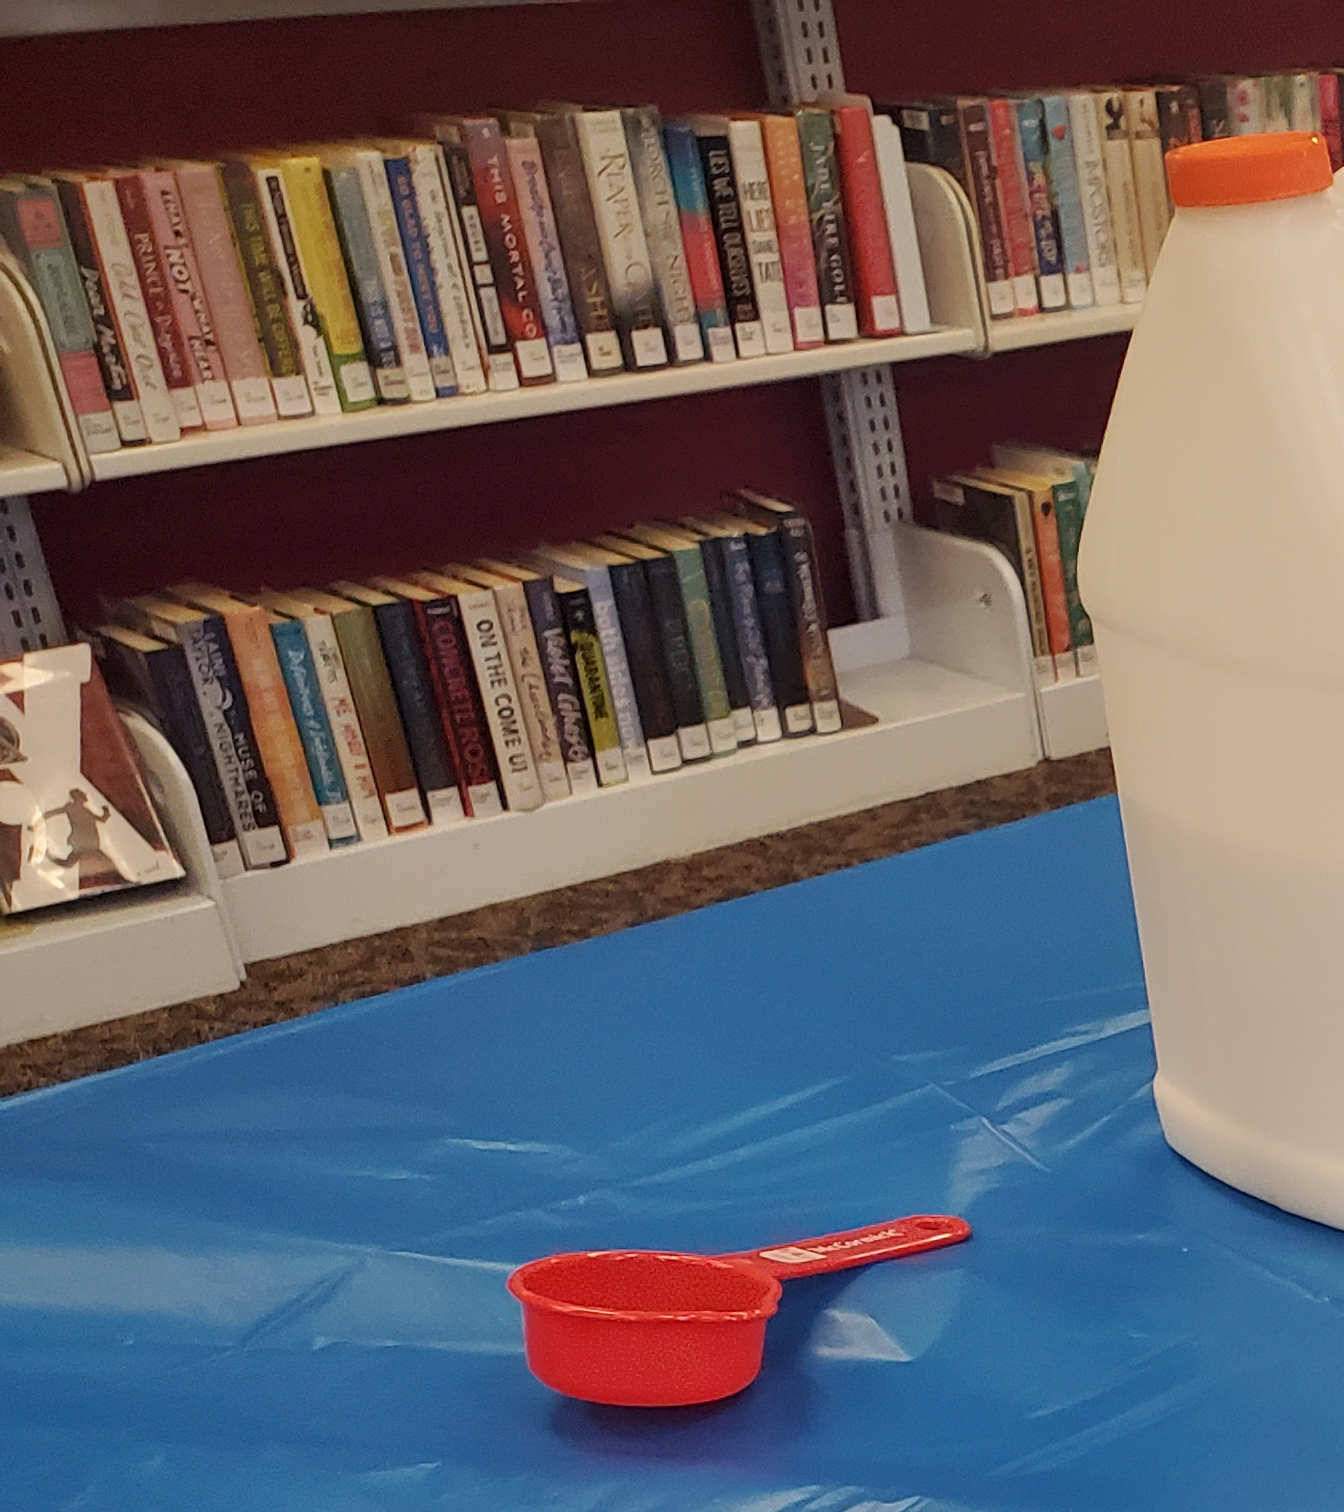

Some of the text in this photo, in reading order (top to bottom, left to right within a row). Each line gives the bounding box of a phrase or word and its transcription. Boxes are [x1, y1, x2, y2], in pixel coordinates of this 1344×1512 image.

[484, 154, 538, 339] THIS MORTAL CO
[164, 242, 193, 295] NOT
[188, 333, 214, 384] HEAR
[474, 617, 499, 649] ON
[484, 651, 508, 690] THE
[493, 691, 523, 748] COME
[209, 720, 258, 833] NIGHTMARES
[232, 729, 259, 783] MUSE
